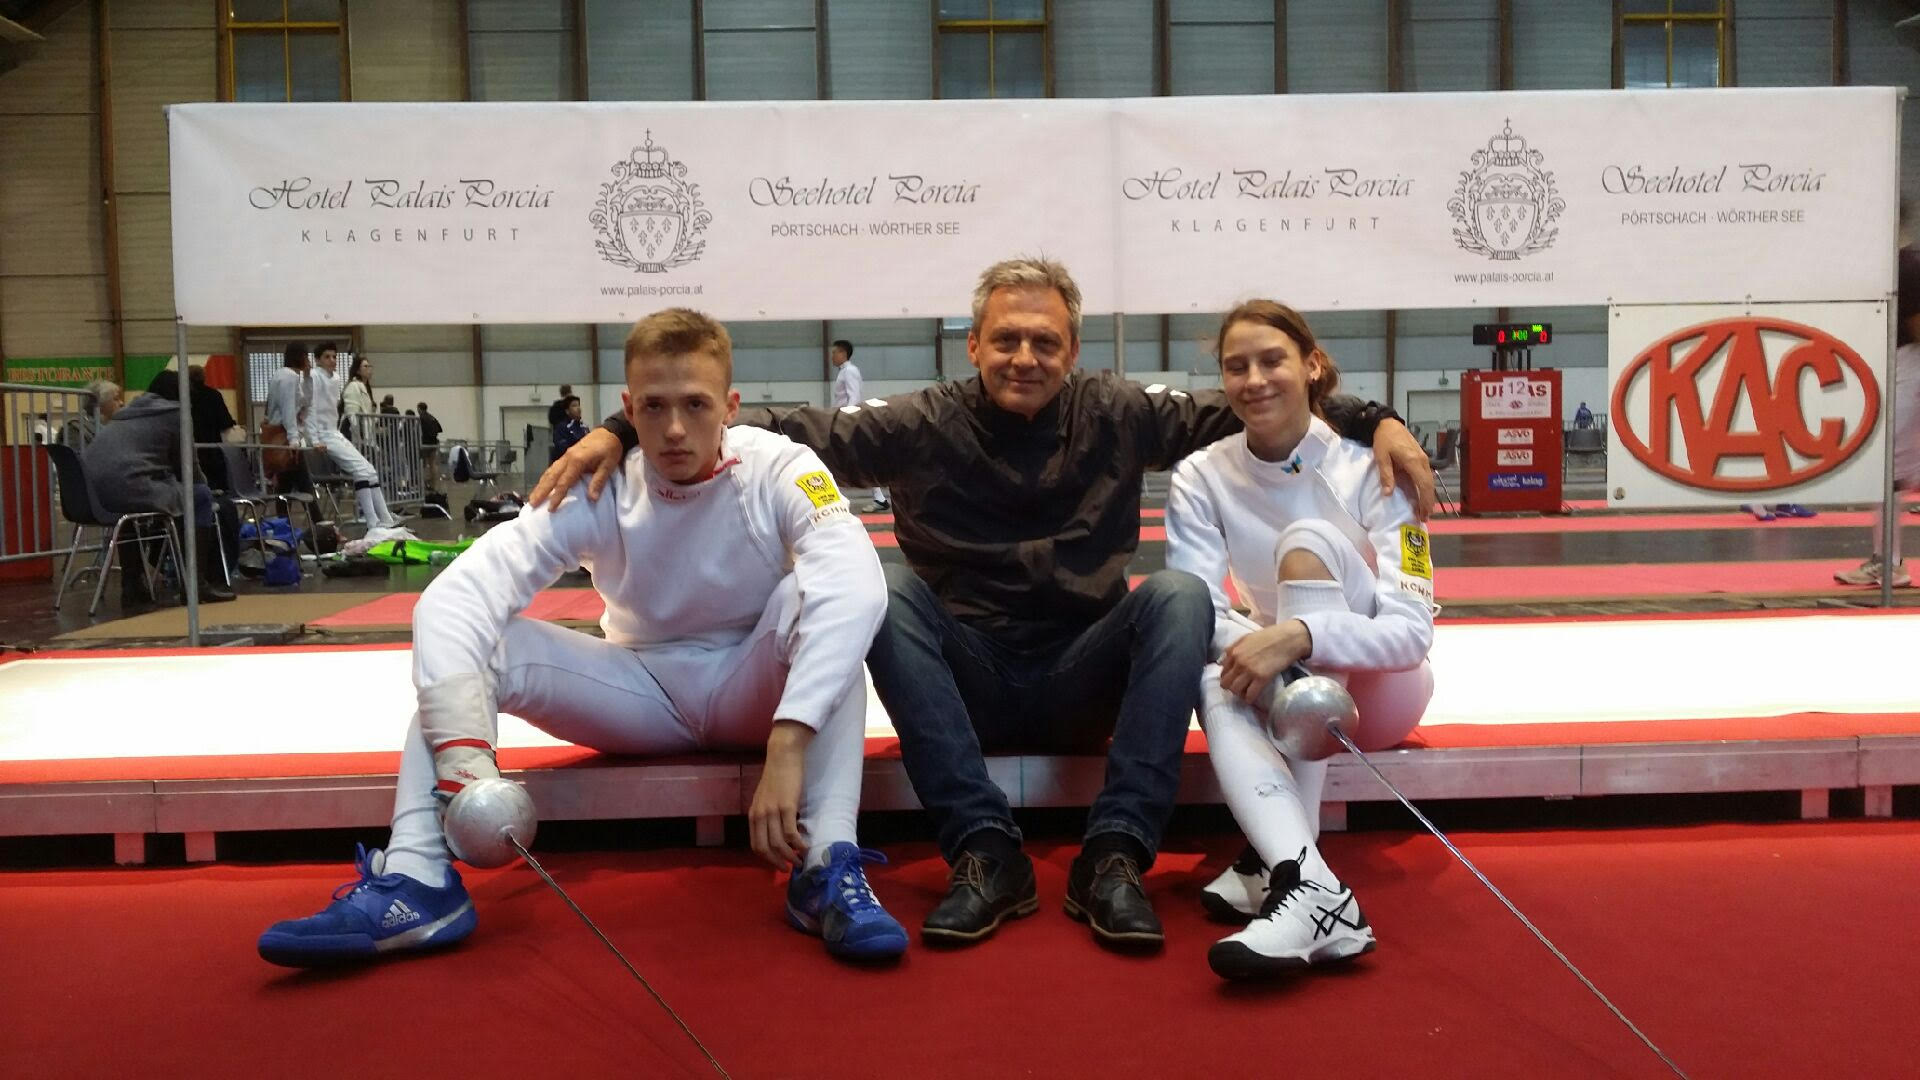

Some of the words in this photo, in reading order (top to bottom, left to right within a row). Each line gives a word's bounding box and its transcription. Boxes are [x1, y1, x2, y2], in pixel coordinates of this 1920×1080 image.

[1122, 167, 1221, 200] Hotel
[1232, 168, 1320, 199] Palais
[1324, 166, 1415, 198] Porcia
[1601, 164, 1727, 195] Seehotel
[1738, 161, 1826, 192] Porcia
[248, 176, 352, 210] Hotel
[364, 177, 455, 209] Palais
[459, 177, 554, 209] Porcia
[748, 176, 877, 207] Seehotel
[888, 173, 980, 204] Porcia
[1171, 217, 1379, 232] KLAGENFURT
[1621, 209, 1707, 225] PÖRTSCHACH
[1717, 208, 1777, 224] WÖRTHER
[1781, 209, 1805, 223] SEE
[301, 229, 519, 241] KLAGENFURT
[771, 221, 858, 237] PÖRTSCHACH
[869, 220, 931, 236] WÖRTHER
[936, 221, 960, 235] SEE
[1454, 271, 1554, 285] www.palais-porcia.at
[600, 284, 704, 298] www.palais-porcia.at
[1508, 380, 1526, 395] 12
[1645, 321, 1848, 482] KAC
[382, 911, 420, 928] adidas
